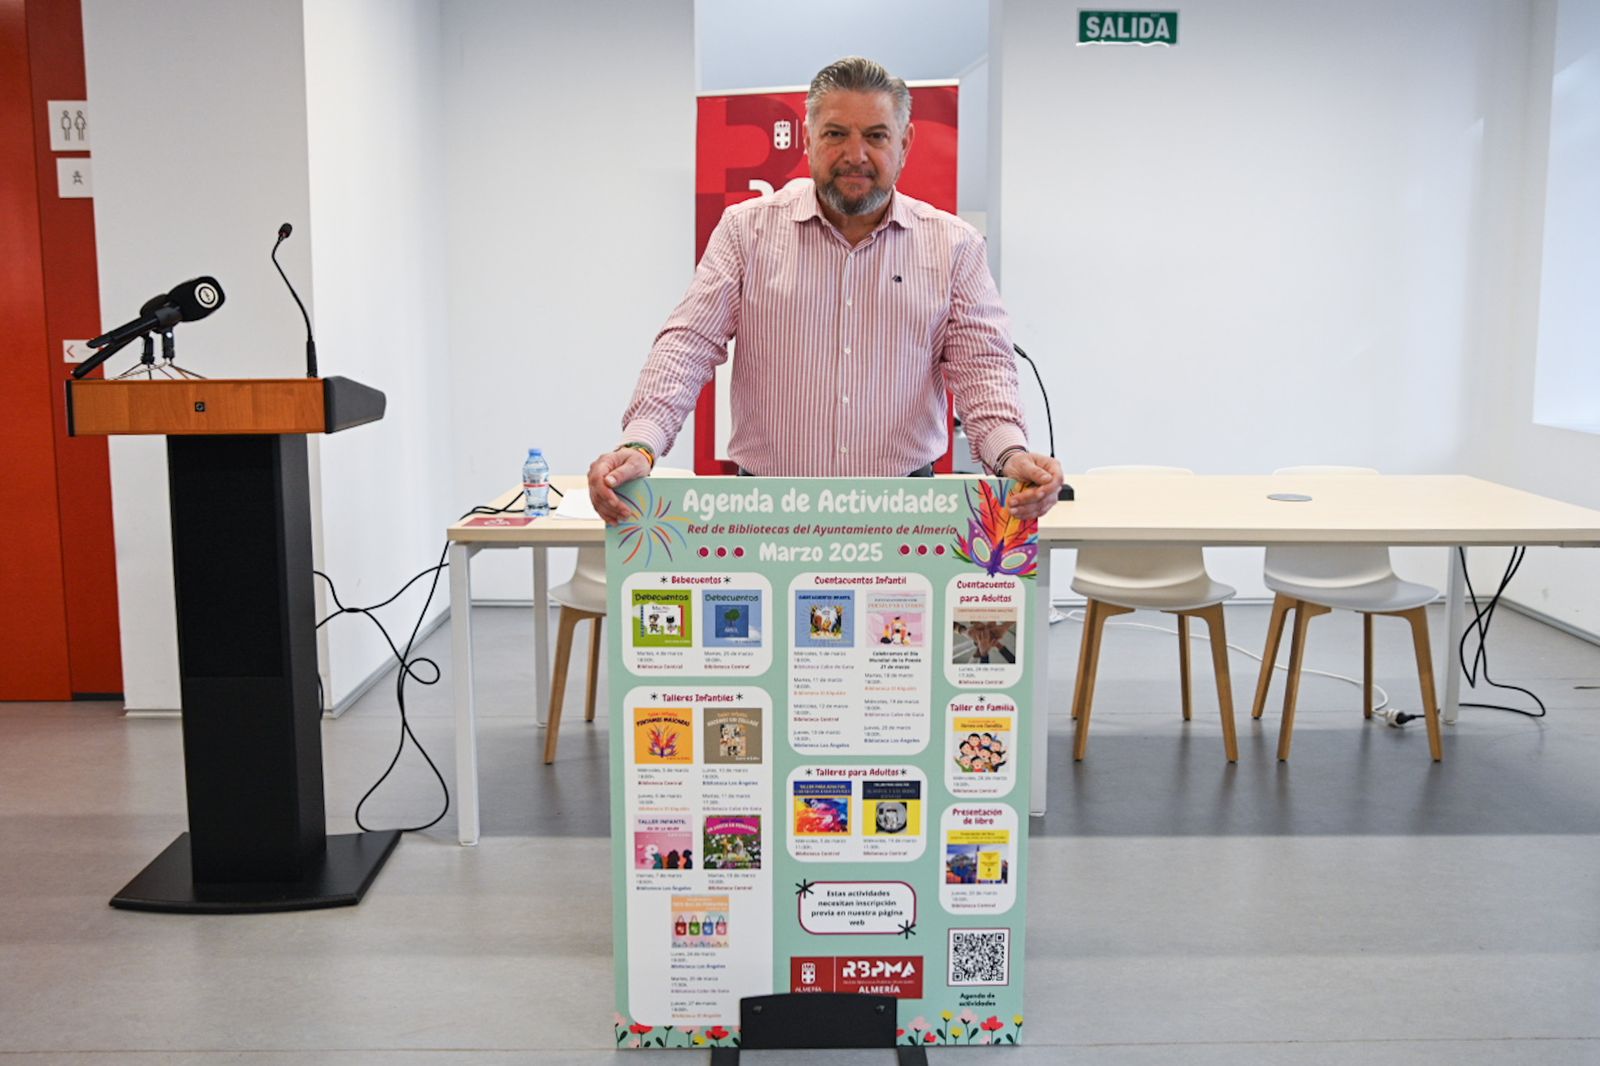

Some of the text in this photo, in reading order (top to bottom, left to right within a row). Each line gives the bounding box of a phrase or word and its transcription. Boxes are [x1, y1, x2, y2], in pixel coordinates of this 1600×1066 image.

[1086, 16, 1170, 38] SALIDA
[682, 488, 958, 521] Agenda de Actividades
[688, 524, 957, 537] Red de Bibliotecas del Ayuntamiento de Almería
[759, 542, 883, 562] Marzo 2025
[672, 576, 721, 584] Bebecuentos
[815, 576, 906, 585] Cuentacuentos Infantil
[957, 580, 1015, 589] Cuentacuentos
[960, 596, 979, 604] para
[662, 694, 734, 702] Talleres Infantiles
[816, 768, 846, 776] Talleres
[952, 808, 1002, 816] Presentación
[858, 985, 900, 993] ALMERÍA
